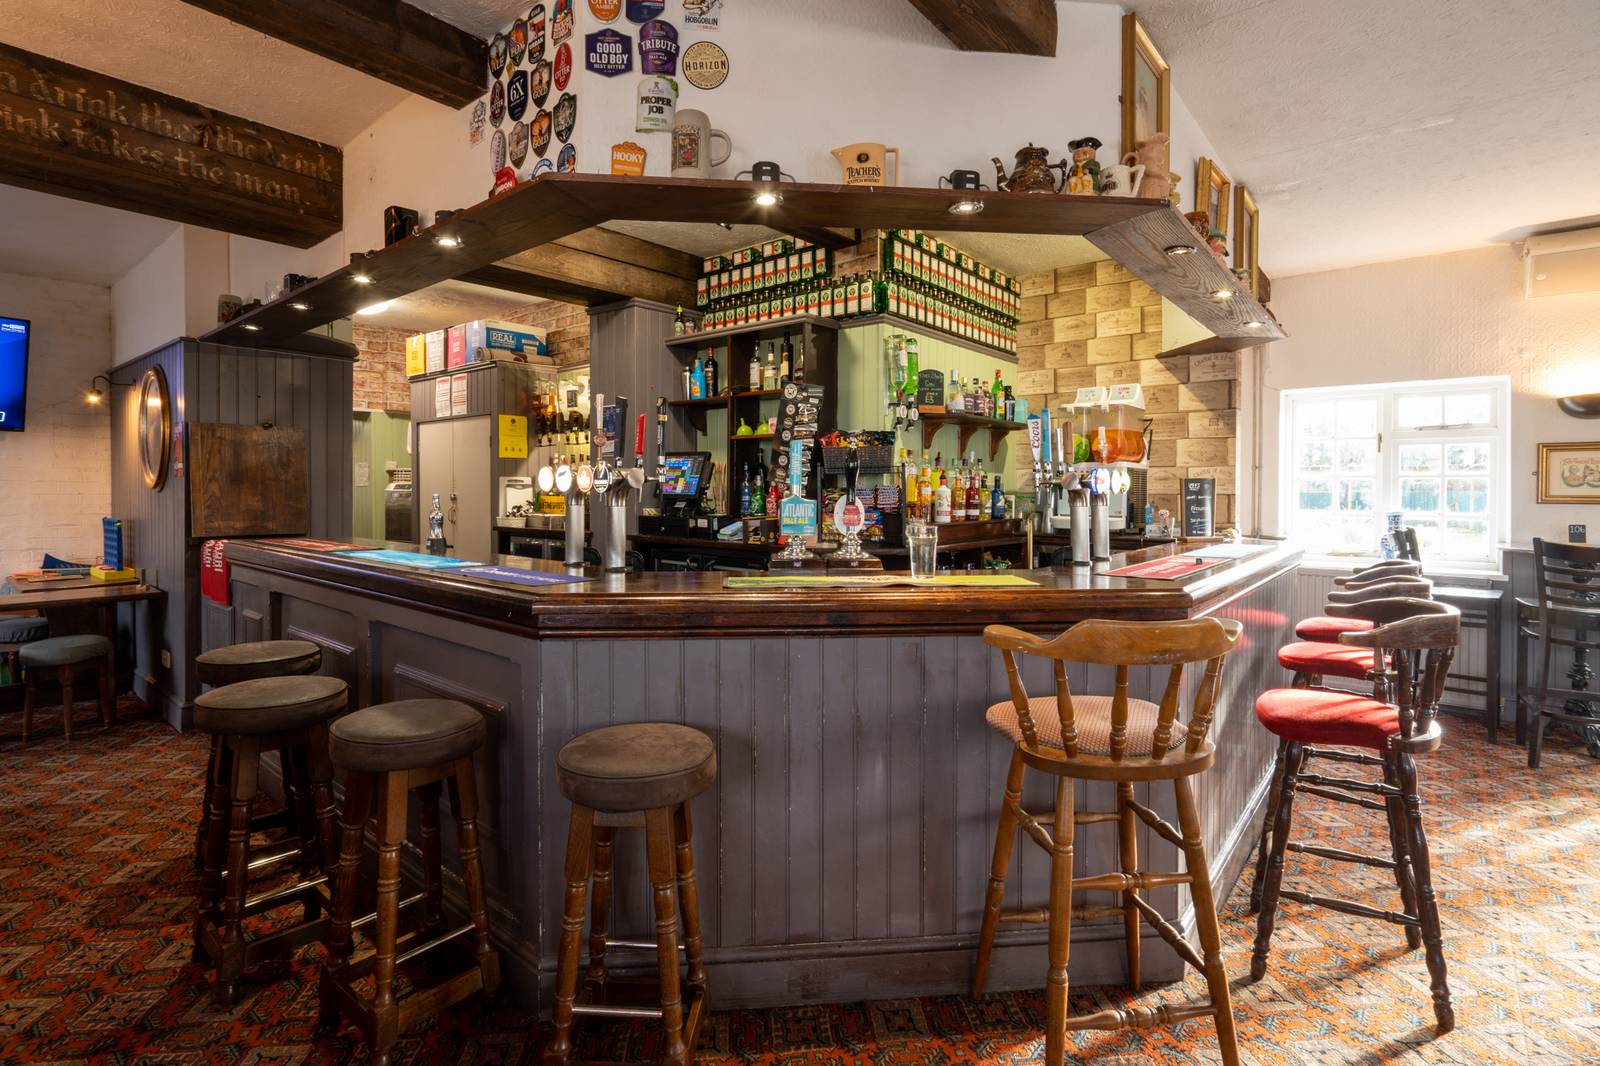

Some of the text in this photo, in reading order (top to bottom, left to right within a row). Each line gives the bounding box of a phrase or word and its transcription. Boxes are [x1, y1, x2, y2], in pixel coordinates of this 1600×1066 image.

[684, 15, 718, 26] HOBGOBLIN
[596, 42, 622, 53] GOOD
[641, 39, 676, 53] TRIBUTE
[590, 52, 628, 65] OLD BOY
[685, 60, 727, 71] HORIZON
[510, 78, 525, 102] 6X
[640, 96, 673, 107] PROPER
[647, 105, 664, 116] JOB
[613, 151, 643, 163] HOOKY
[174, 147, 225, 185] the
[846, 165, 881, 179] TEACHER'S
[491, 331, 514, 343] REAL
[1031, 420, 1040, 449] Coors
[782, 503, 814, 517] ATLANTIC
